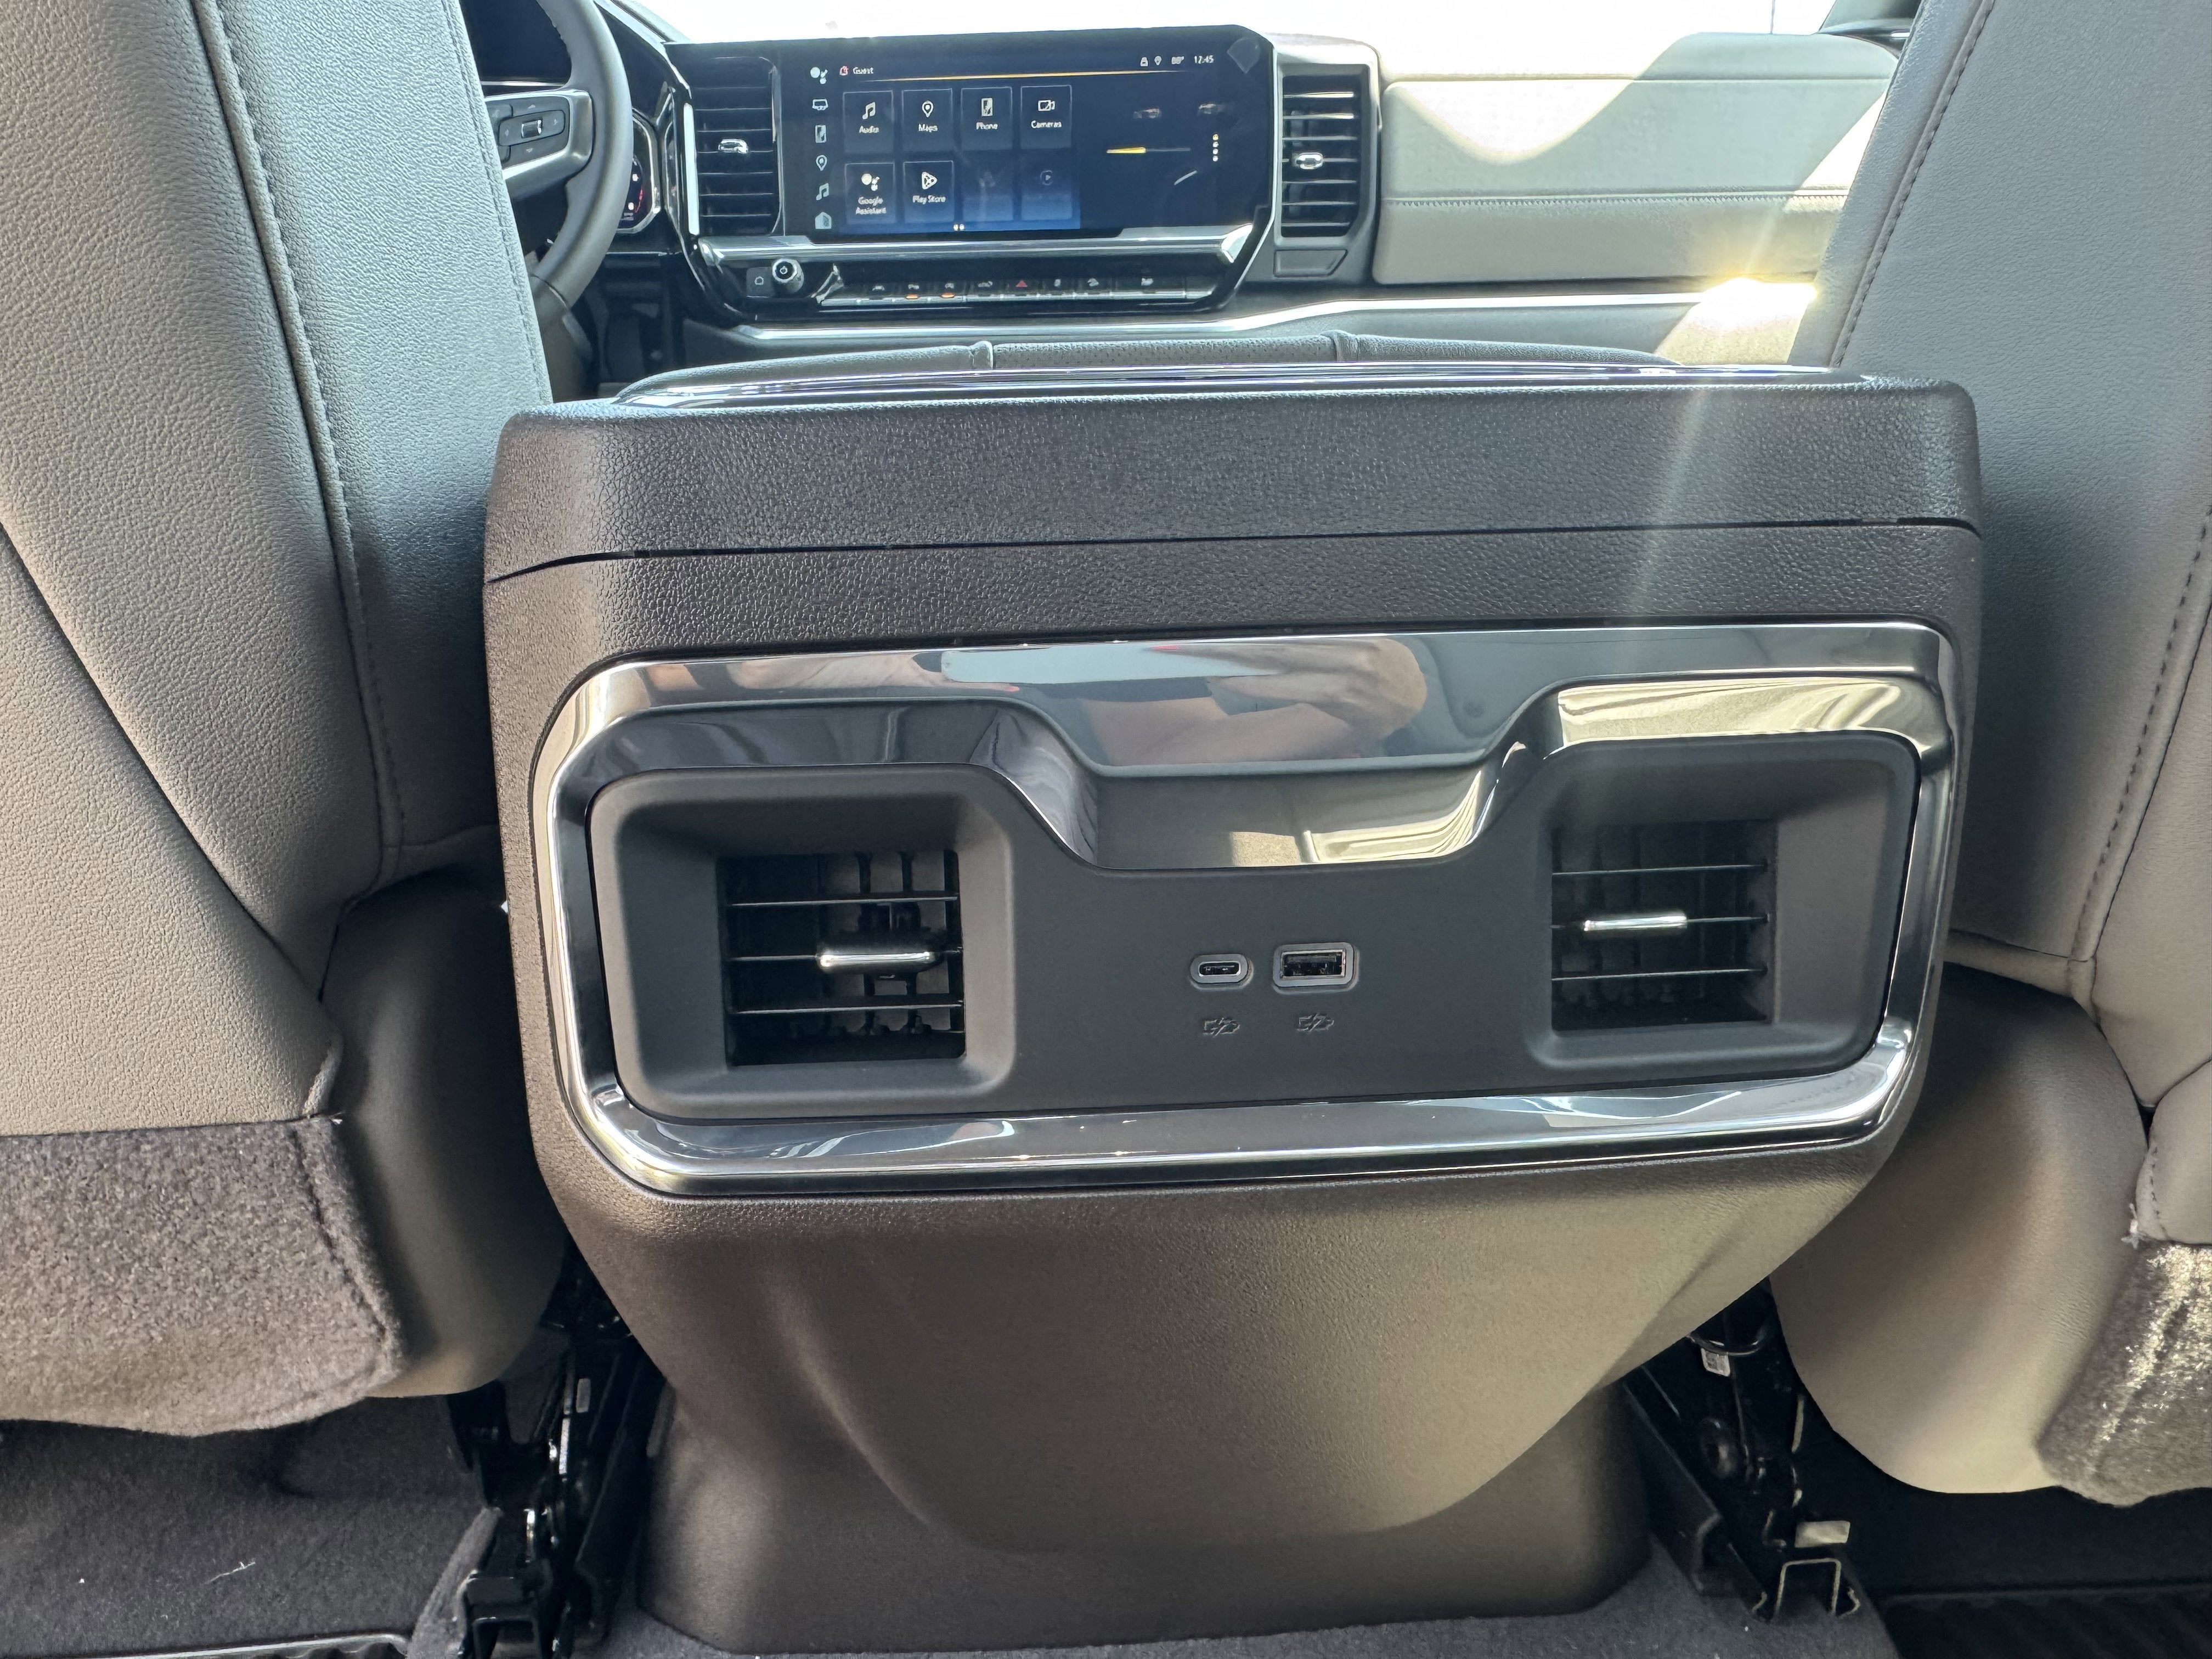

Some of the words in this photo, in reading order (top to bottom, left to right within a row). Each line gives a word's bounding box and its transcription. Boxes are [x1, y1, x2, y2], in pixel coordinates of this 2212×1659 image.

[1194, 55, 1214, 64] 12:45
[853, 66, 874, 75] Guest
[918, 123, 938, 132] Maps
[976, 122, 998, 130] Phone
[1031, 120, 1062, 129] Cameras
[859, 125, 879, 134] Audio
[857, 196, 884, 206] Google
[912, 195, 927, 205] Play
[928, 195, 946, 203] Store
